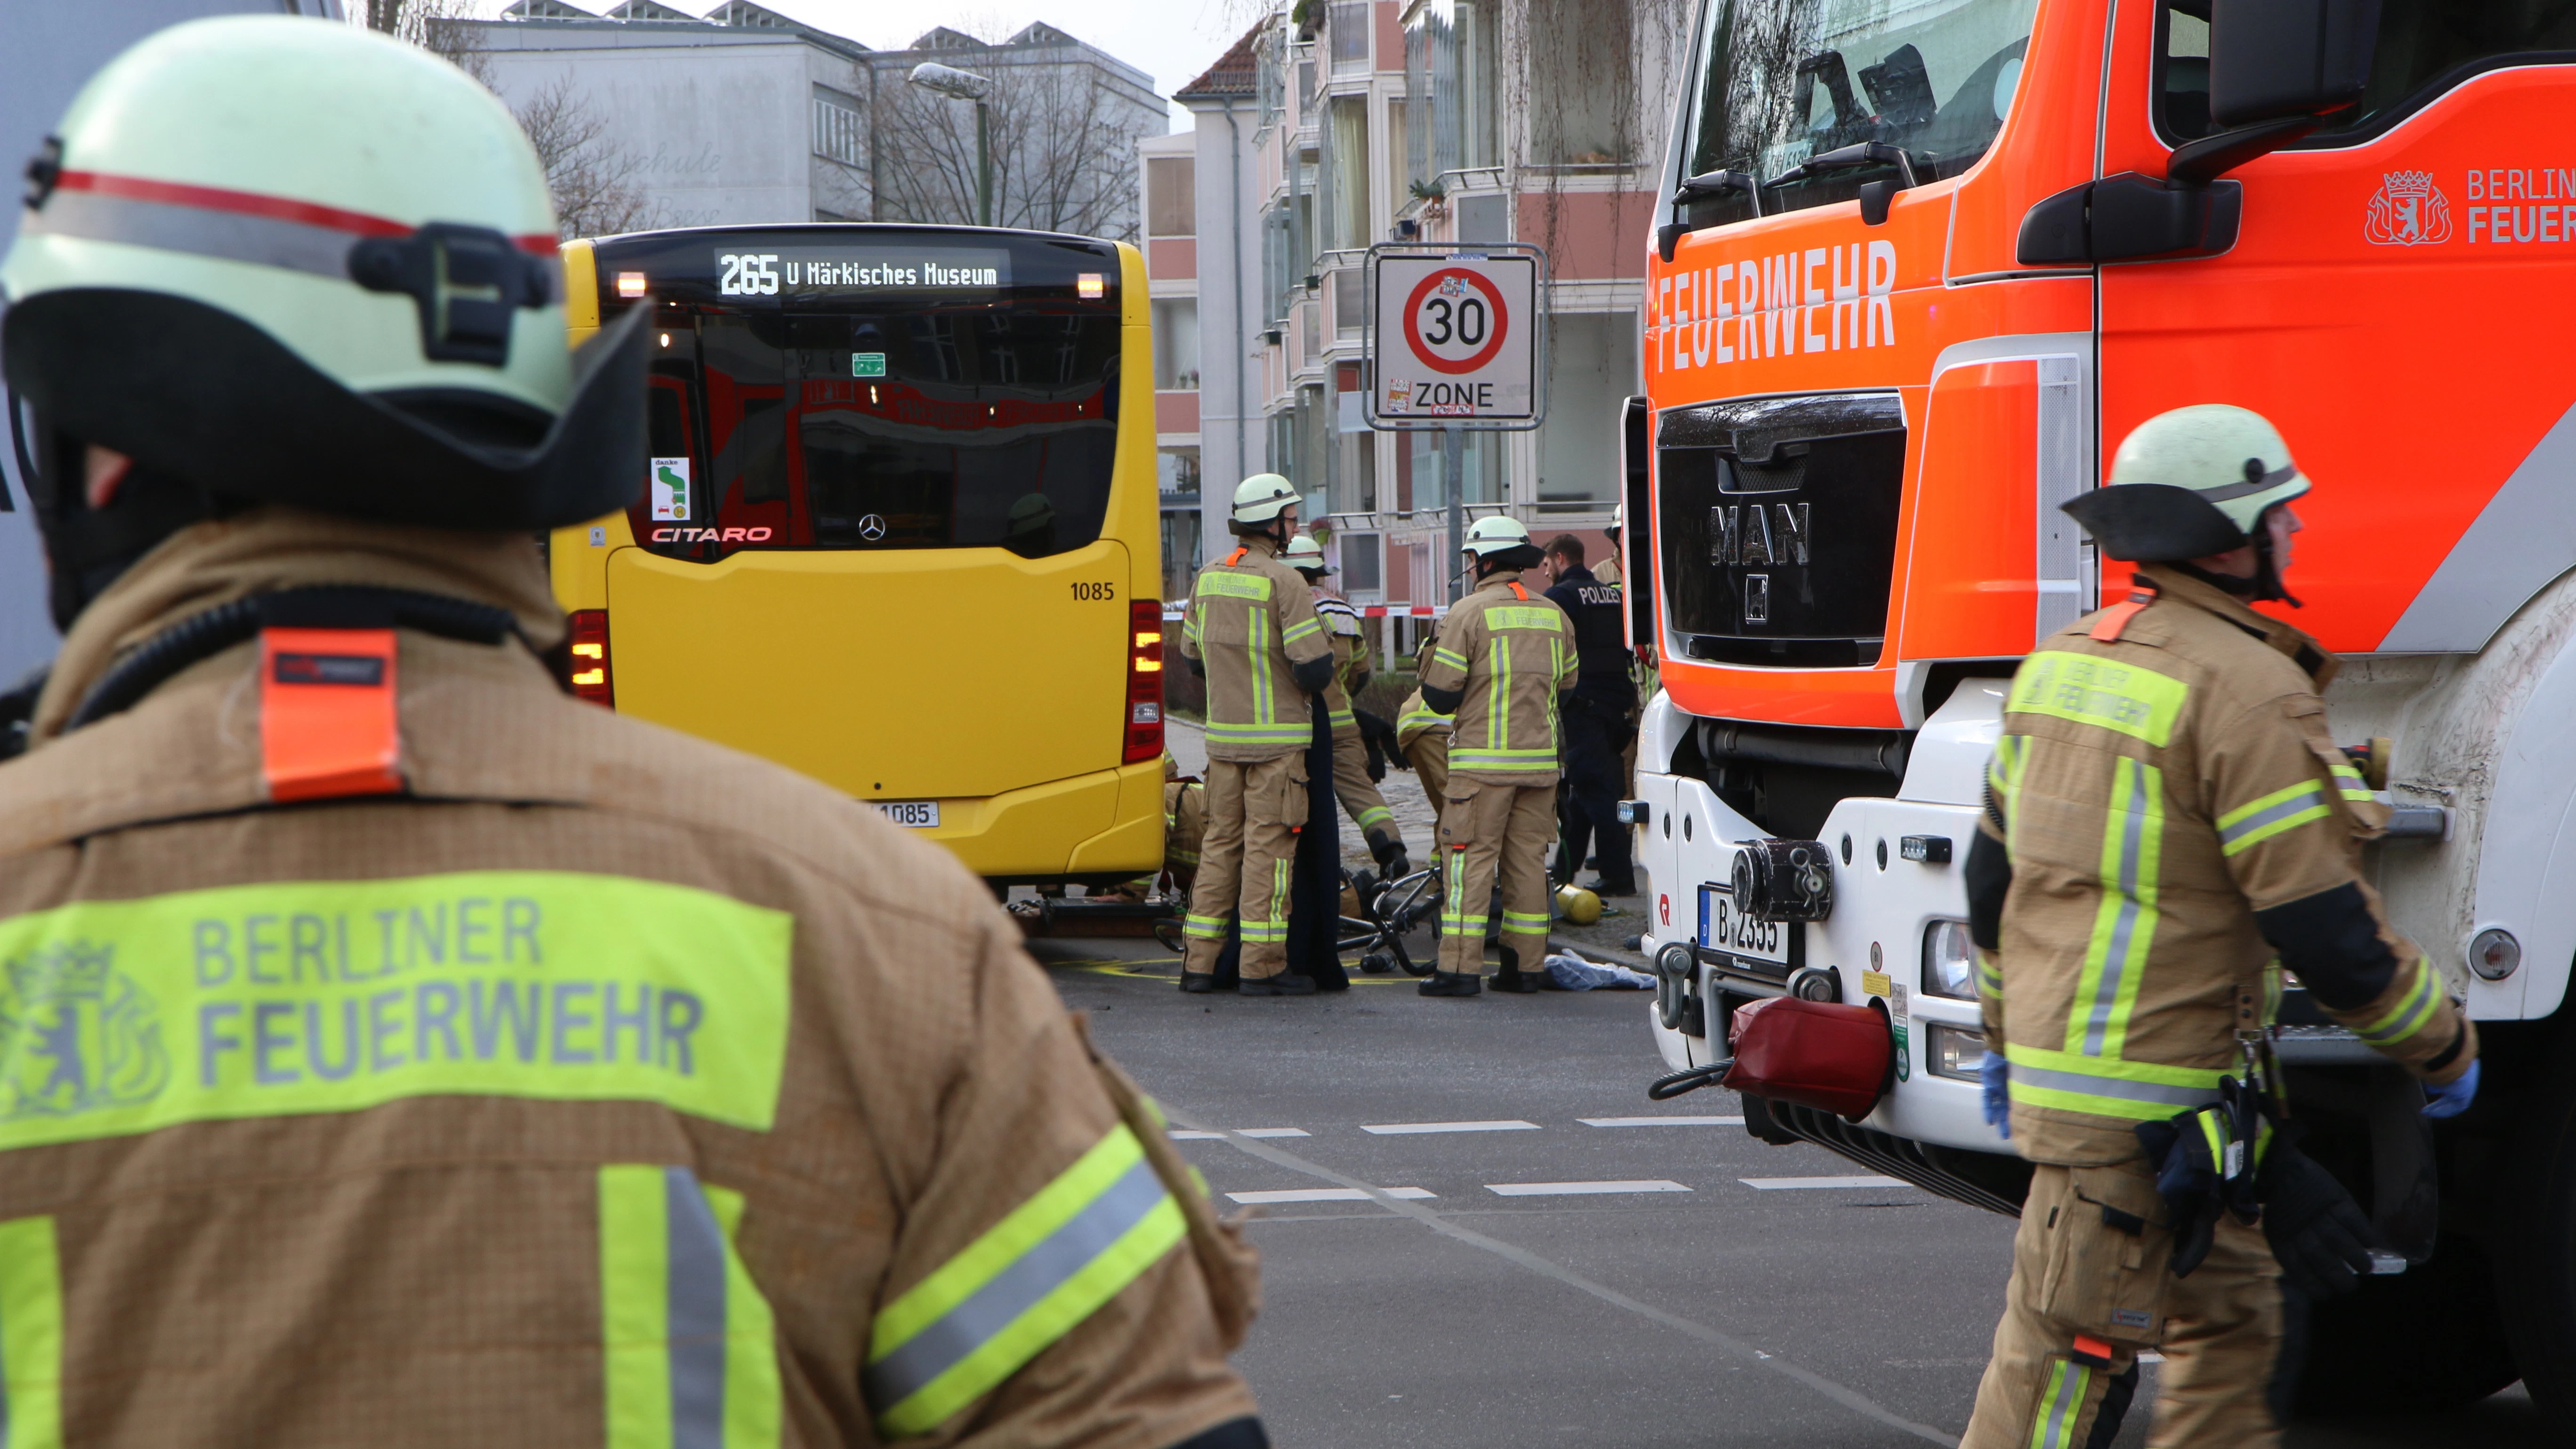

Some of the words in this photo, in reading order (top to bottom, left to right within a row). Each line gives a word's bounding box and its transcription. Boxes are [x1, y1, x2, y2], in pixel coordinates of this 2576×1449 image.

[621, 141, 722, 175] chule
[2467, 168, 2576, 200] BERLIN
[2468, 205, 2576, 243] FEUER
[721, 255, 779, 296] 265
[787, 262, 799, 285] U
[807, 262, 917, 285] Märkisches
[924, 262, 997, 285] Museum
[1425, 298, 1485, 346] 30
[1657, 240, 1897, 373] FEUERWEHR
[1416, 383, 1493, 407] ZONE
[651, 527, 772, 542] CITARO
[1709, 503, 1810, 566] MAN
[1071, 582, 1114, 601] 1085
[1216, 583, 1259, 596] FEUERWEHR
[1515, 616, 1556, 628] FEUERWEHR
[1703, 924, 1707, 937] D
[1719, 897, 1728, 943] B
[193, 895, 545, 989] BERLINER
[197, 977, 705, 1090] FEUERWEHR
